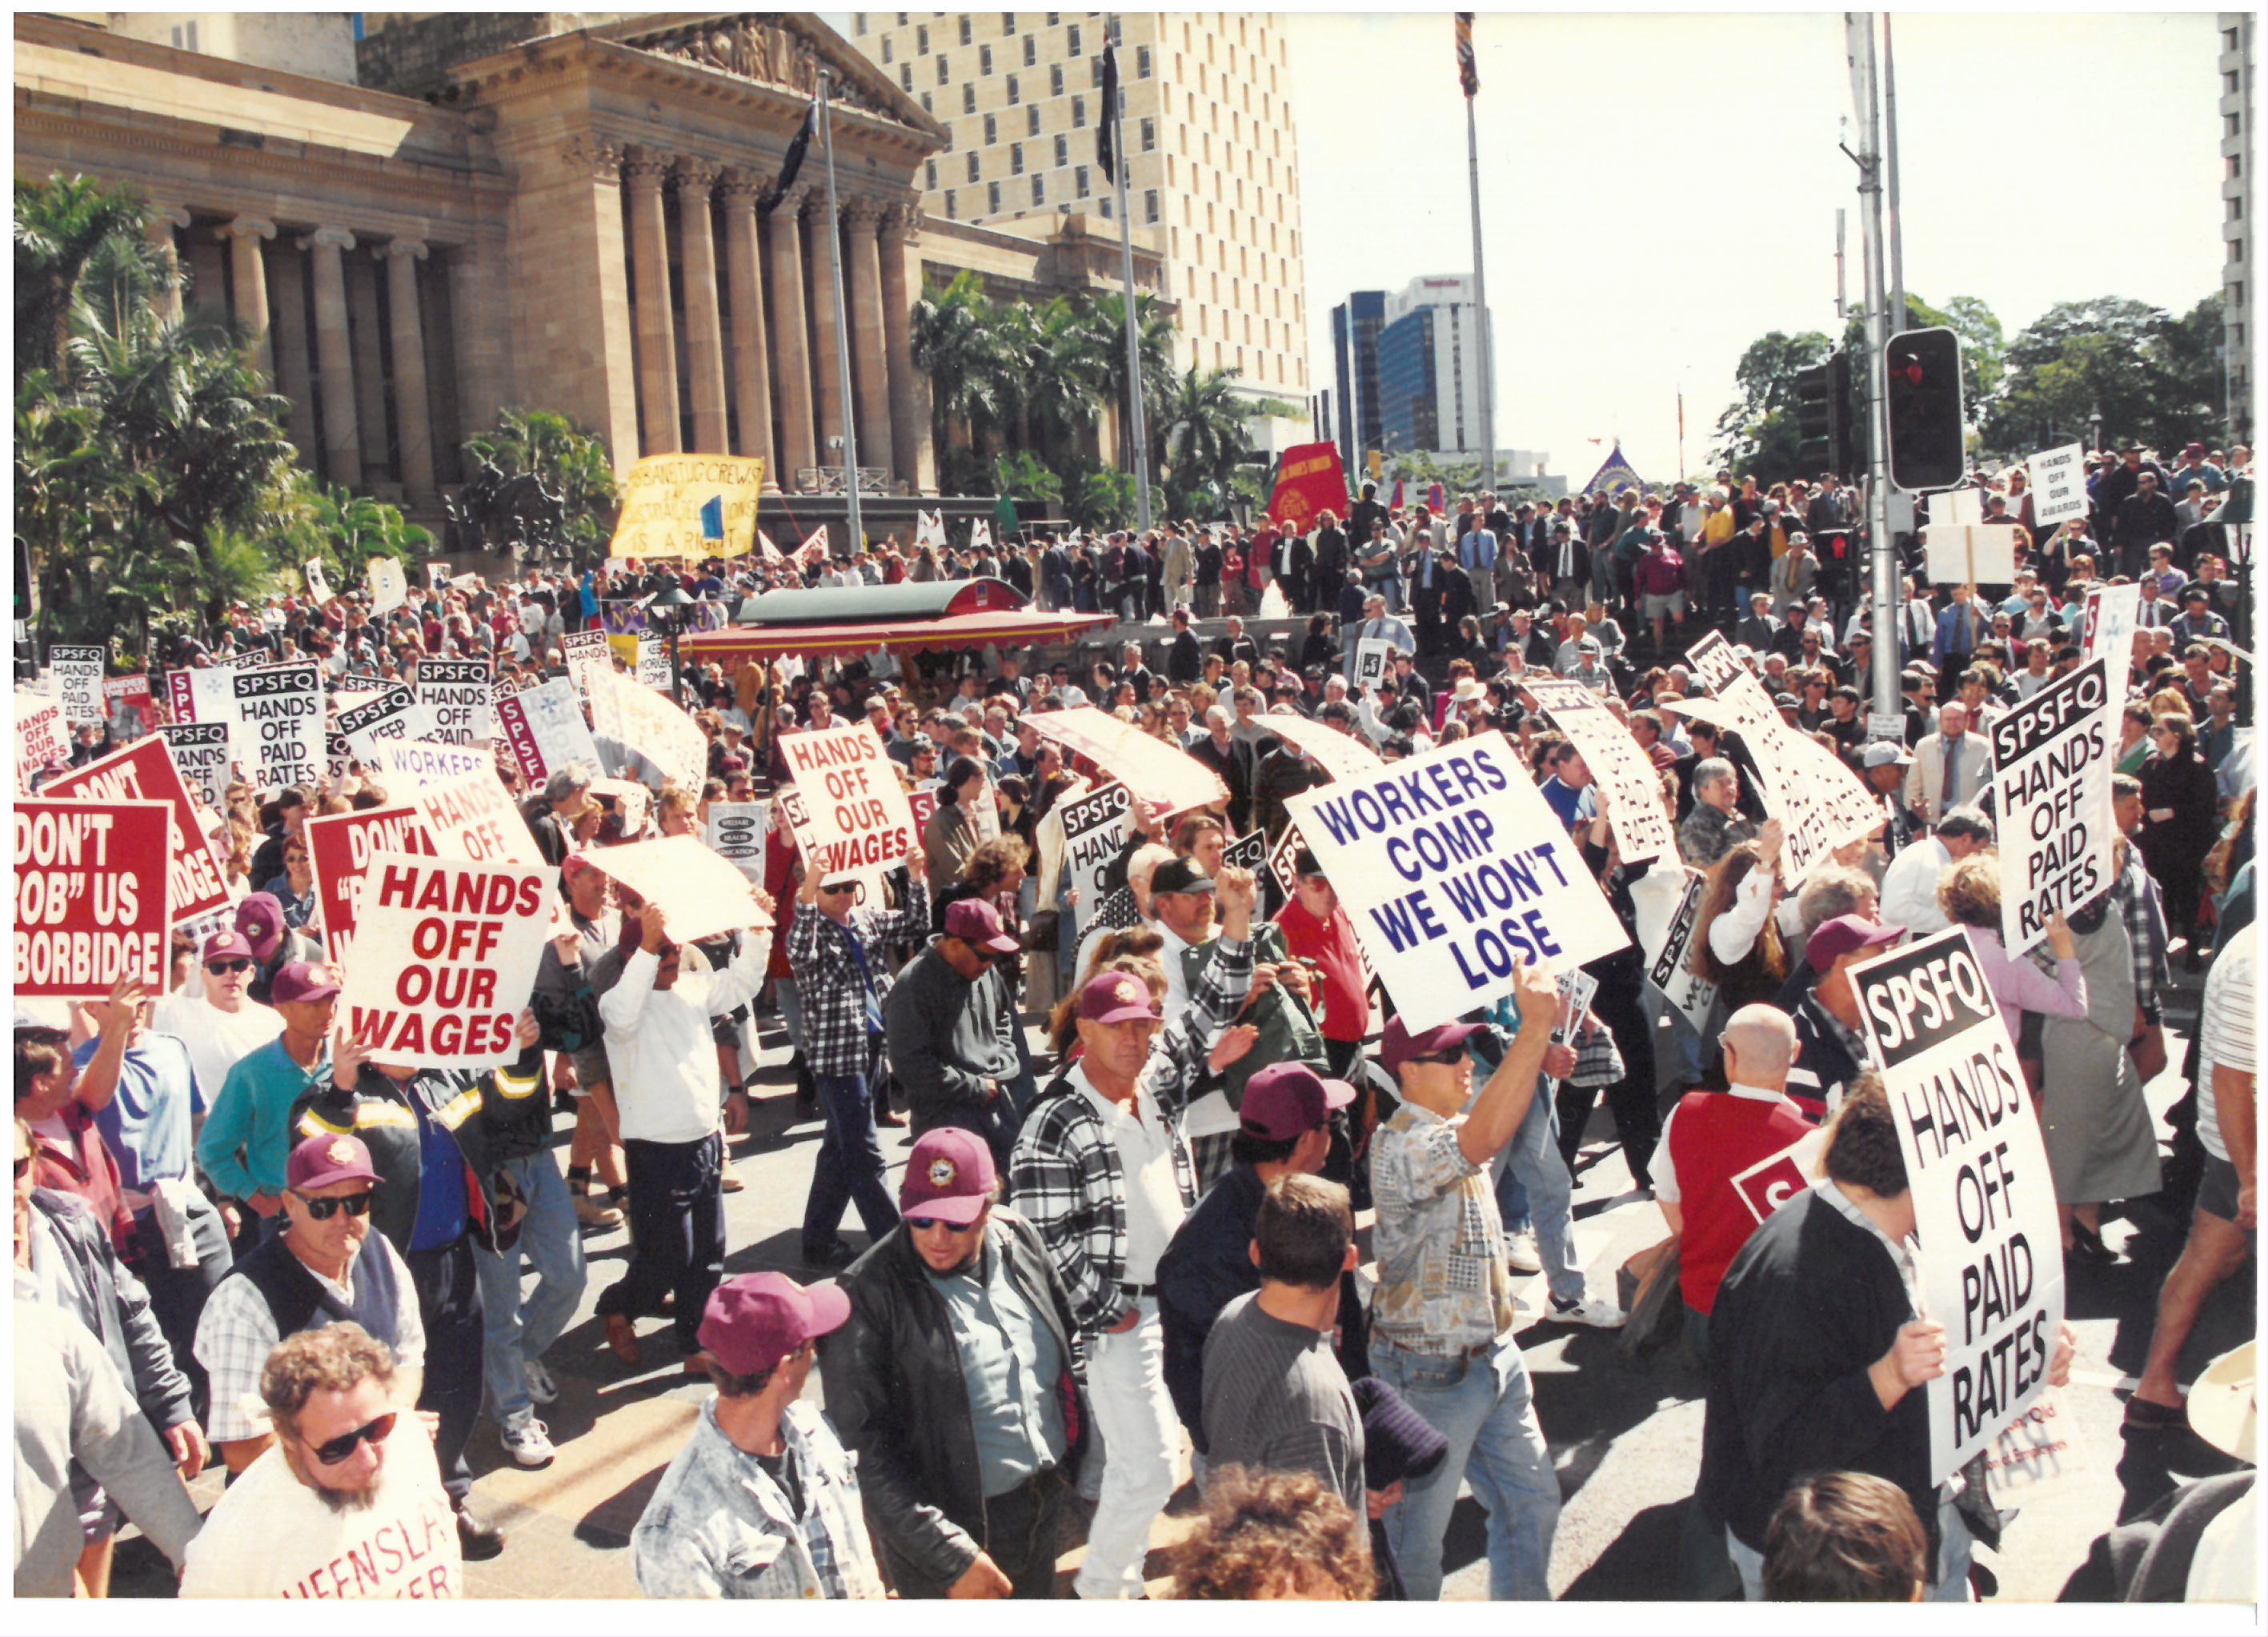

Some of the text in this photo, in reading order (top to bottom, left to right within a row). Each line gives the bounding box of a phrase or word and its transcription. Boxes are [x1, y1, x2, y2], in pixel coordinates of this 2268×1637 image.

[706, 462, 763, 486] CREWS
[2040, 454, 2071, 469] HANDS
[2048, 471, 2066, 484] OFF
[2042, 499, 2082, 518] AWARDS
[2050, 486, 2070, 499] OUR
[632, 531, 649, 553] IS
[665, 533, 678, 552] A
[52, 647, 102, 660] SPSFQ
[565, 633, 604, 647] SPSFQ
[569, 646, 607, 661] HANDS
[54, 665, 99, 676] HANDS
[64, 678, 88, 689] OFF
[103, 677, 146, 693] UNDER
[237, 673, 315, 694] SPSFQ
[421, 665, 487, 682] SPSFQ
[643, 671, 667, 685] COMP
[62, 692, 89, 704] PAID
[66, 706, 94, 718] ATES
[241, 697, 317, 721] HANDS
[341, 692, 411, 730] SPSFQ
[422, 688, 486, 706] HANDS
[25, 722, 50, 742] OFF
[261, 720, 302, 741] OFF
[436, 708, 471, 726] OFF
[1998, 674, 2103, 760] SPSFQ
[26, 735, 54, 757] OUR
[173, 748, 226, 767] ANDS
[260, 742, 306, 764] PAID
[503, 702, 548, 793] SPSFQ
[791, 733, 877, 771] HANDS
[256, 763, 316, 788] RATES
[824, 766, 870, 800] OFF
[2004, 720, 2105, 818] HANDS
[423, 776, 503, 832] HANDS
[835, 798, 889, 835] OUR
[1064, 787, 1130, 834] SPSFQ
[1312, 749, 1509, 847] WORKERS
[2030, 777, 2083, 842] OFF
[14, 811, 113, 867] DON'T
[463, 820, 506, 862] OFF
[827, 827, 908, 874] WAGES
[1386, 808, 1495, 883] COMP
[1621, 814, 1666, 853] RATES
[1787, 806, 1828, 873] RATES
[2029, 822, 2087, 890] PAID
[94, 872, 138, 926] US
[379, 865, 543, 917] HANDS
[1368, 889, 1448, 955] WE
[1440, 842, 1569, 924] WON'T
[2020, 854, 2099, 941] RATES
[14, 931, 160, 985] BORBIDGE
[412, 917, 503, 962] OFF
[1449, 909, 1562, 991] LOSE
[396, 964, 498, 1010] OUR
[1868, 950, 1990, 1051] SPSFQ
[351, 1006, 515, 1055] WAGES
[1902, 1043, 2021, 1169] HANDS
[1956, 1141, 2014, 1244] OFF
[1962, 1232, 2033, 1347] PAID
[1953, 1307, 2047, 1450] RATES
[282, 1496, 448, 1599] EENSLA
[396, 1564, 451, 1599] ER
